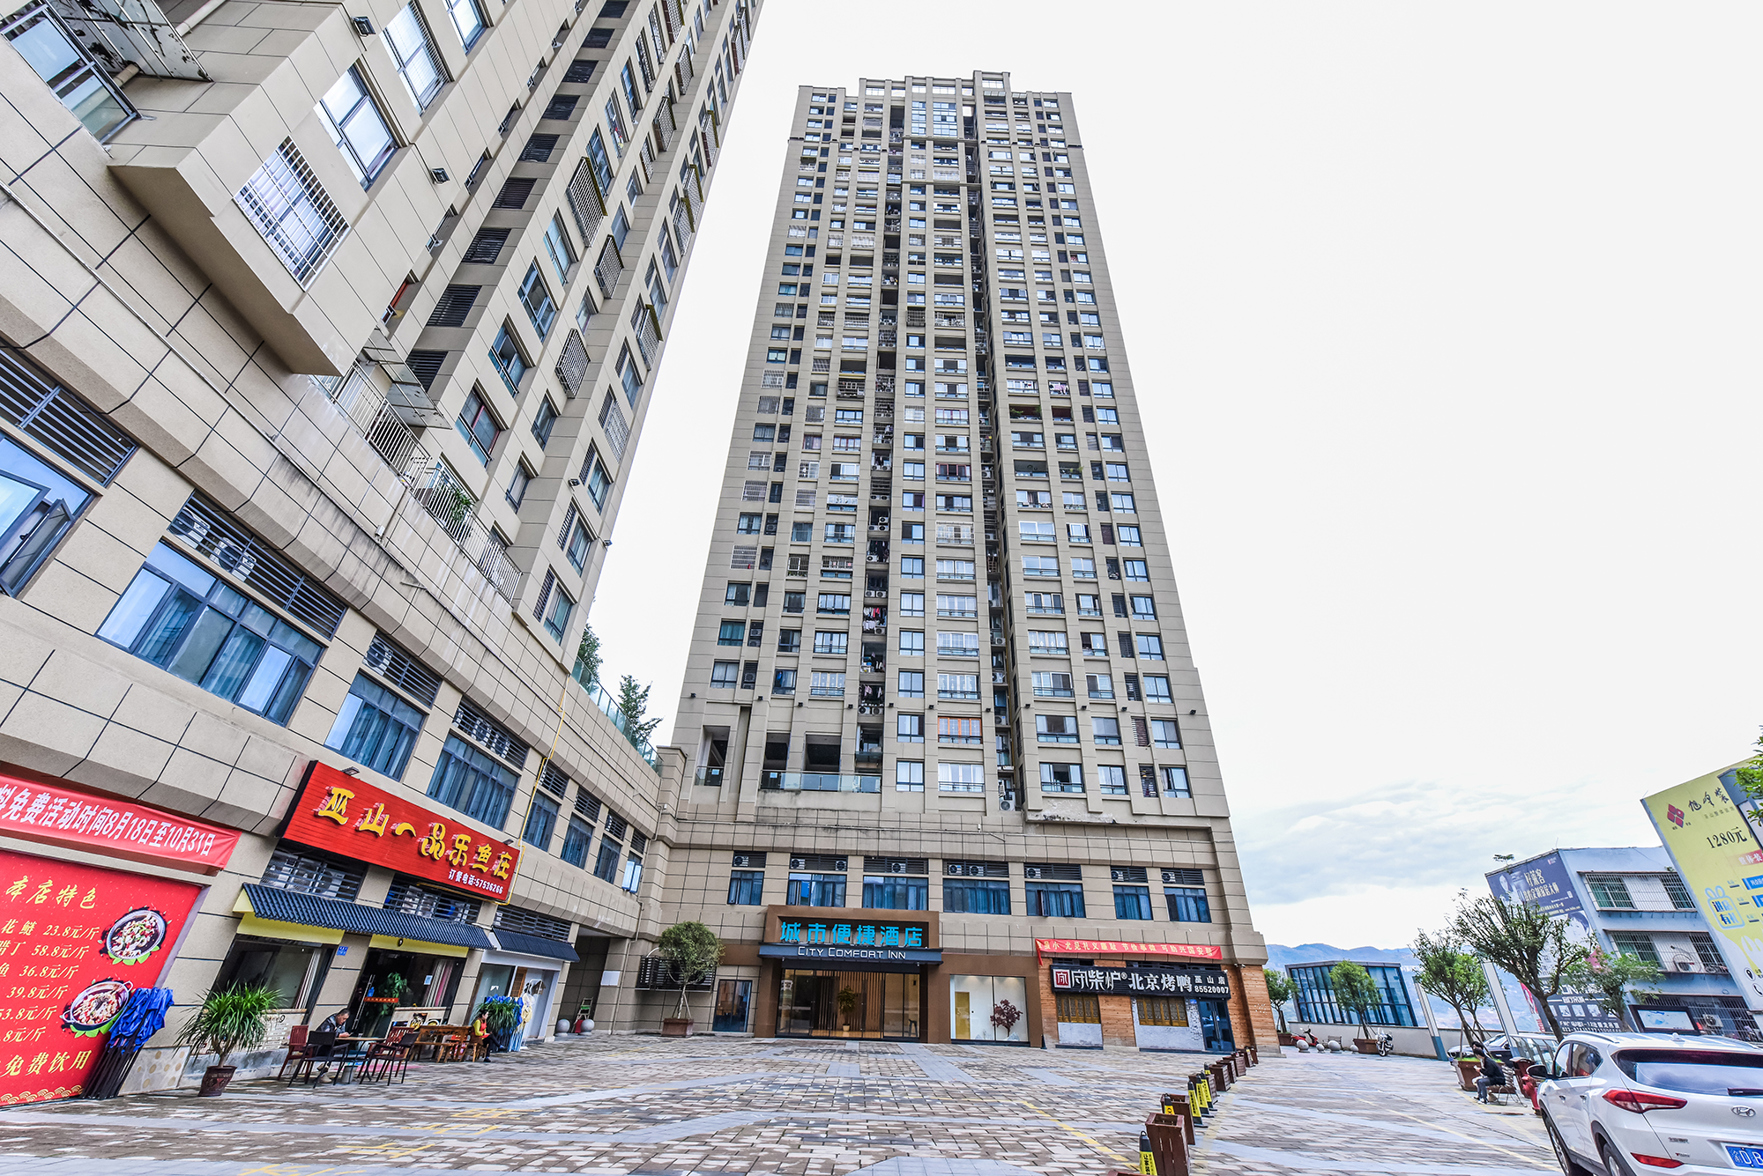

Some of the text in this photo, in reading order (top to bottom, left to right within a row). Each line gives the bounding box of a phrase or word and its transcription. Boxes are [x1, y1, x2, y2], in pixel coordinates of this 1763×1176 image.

[316, 786, 513, 881] 巫山一品乐鱼庄
[1706, 826, 1748, 849] 1280元
[5, 875, 97, 909] 本店特色
[43, 924, 100, 940] 23.8元/斤
[780, 922, 923, 947] 城市便捷酒店
[31, 944, 90, 960] 58.8元/斤
[797, 946, 906, 959] CITY COMFORT INN
[19, 964, 80, 980] 36.8元/斤
[6, 984, 69, 1000] 39.8元/斤
[1194, 985, 1229, 994] 85520007
[0, 1026, 47, 1042] 8元/斤
[0, 1050, 92, 1077] 免费饮用
